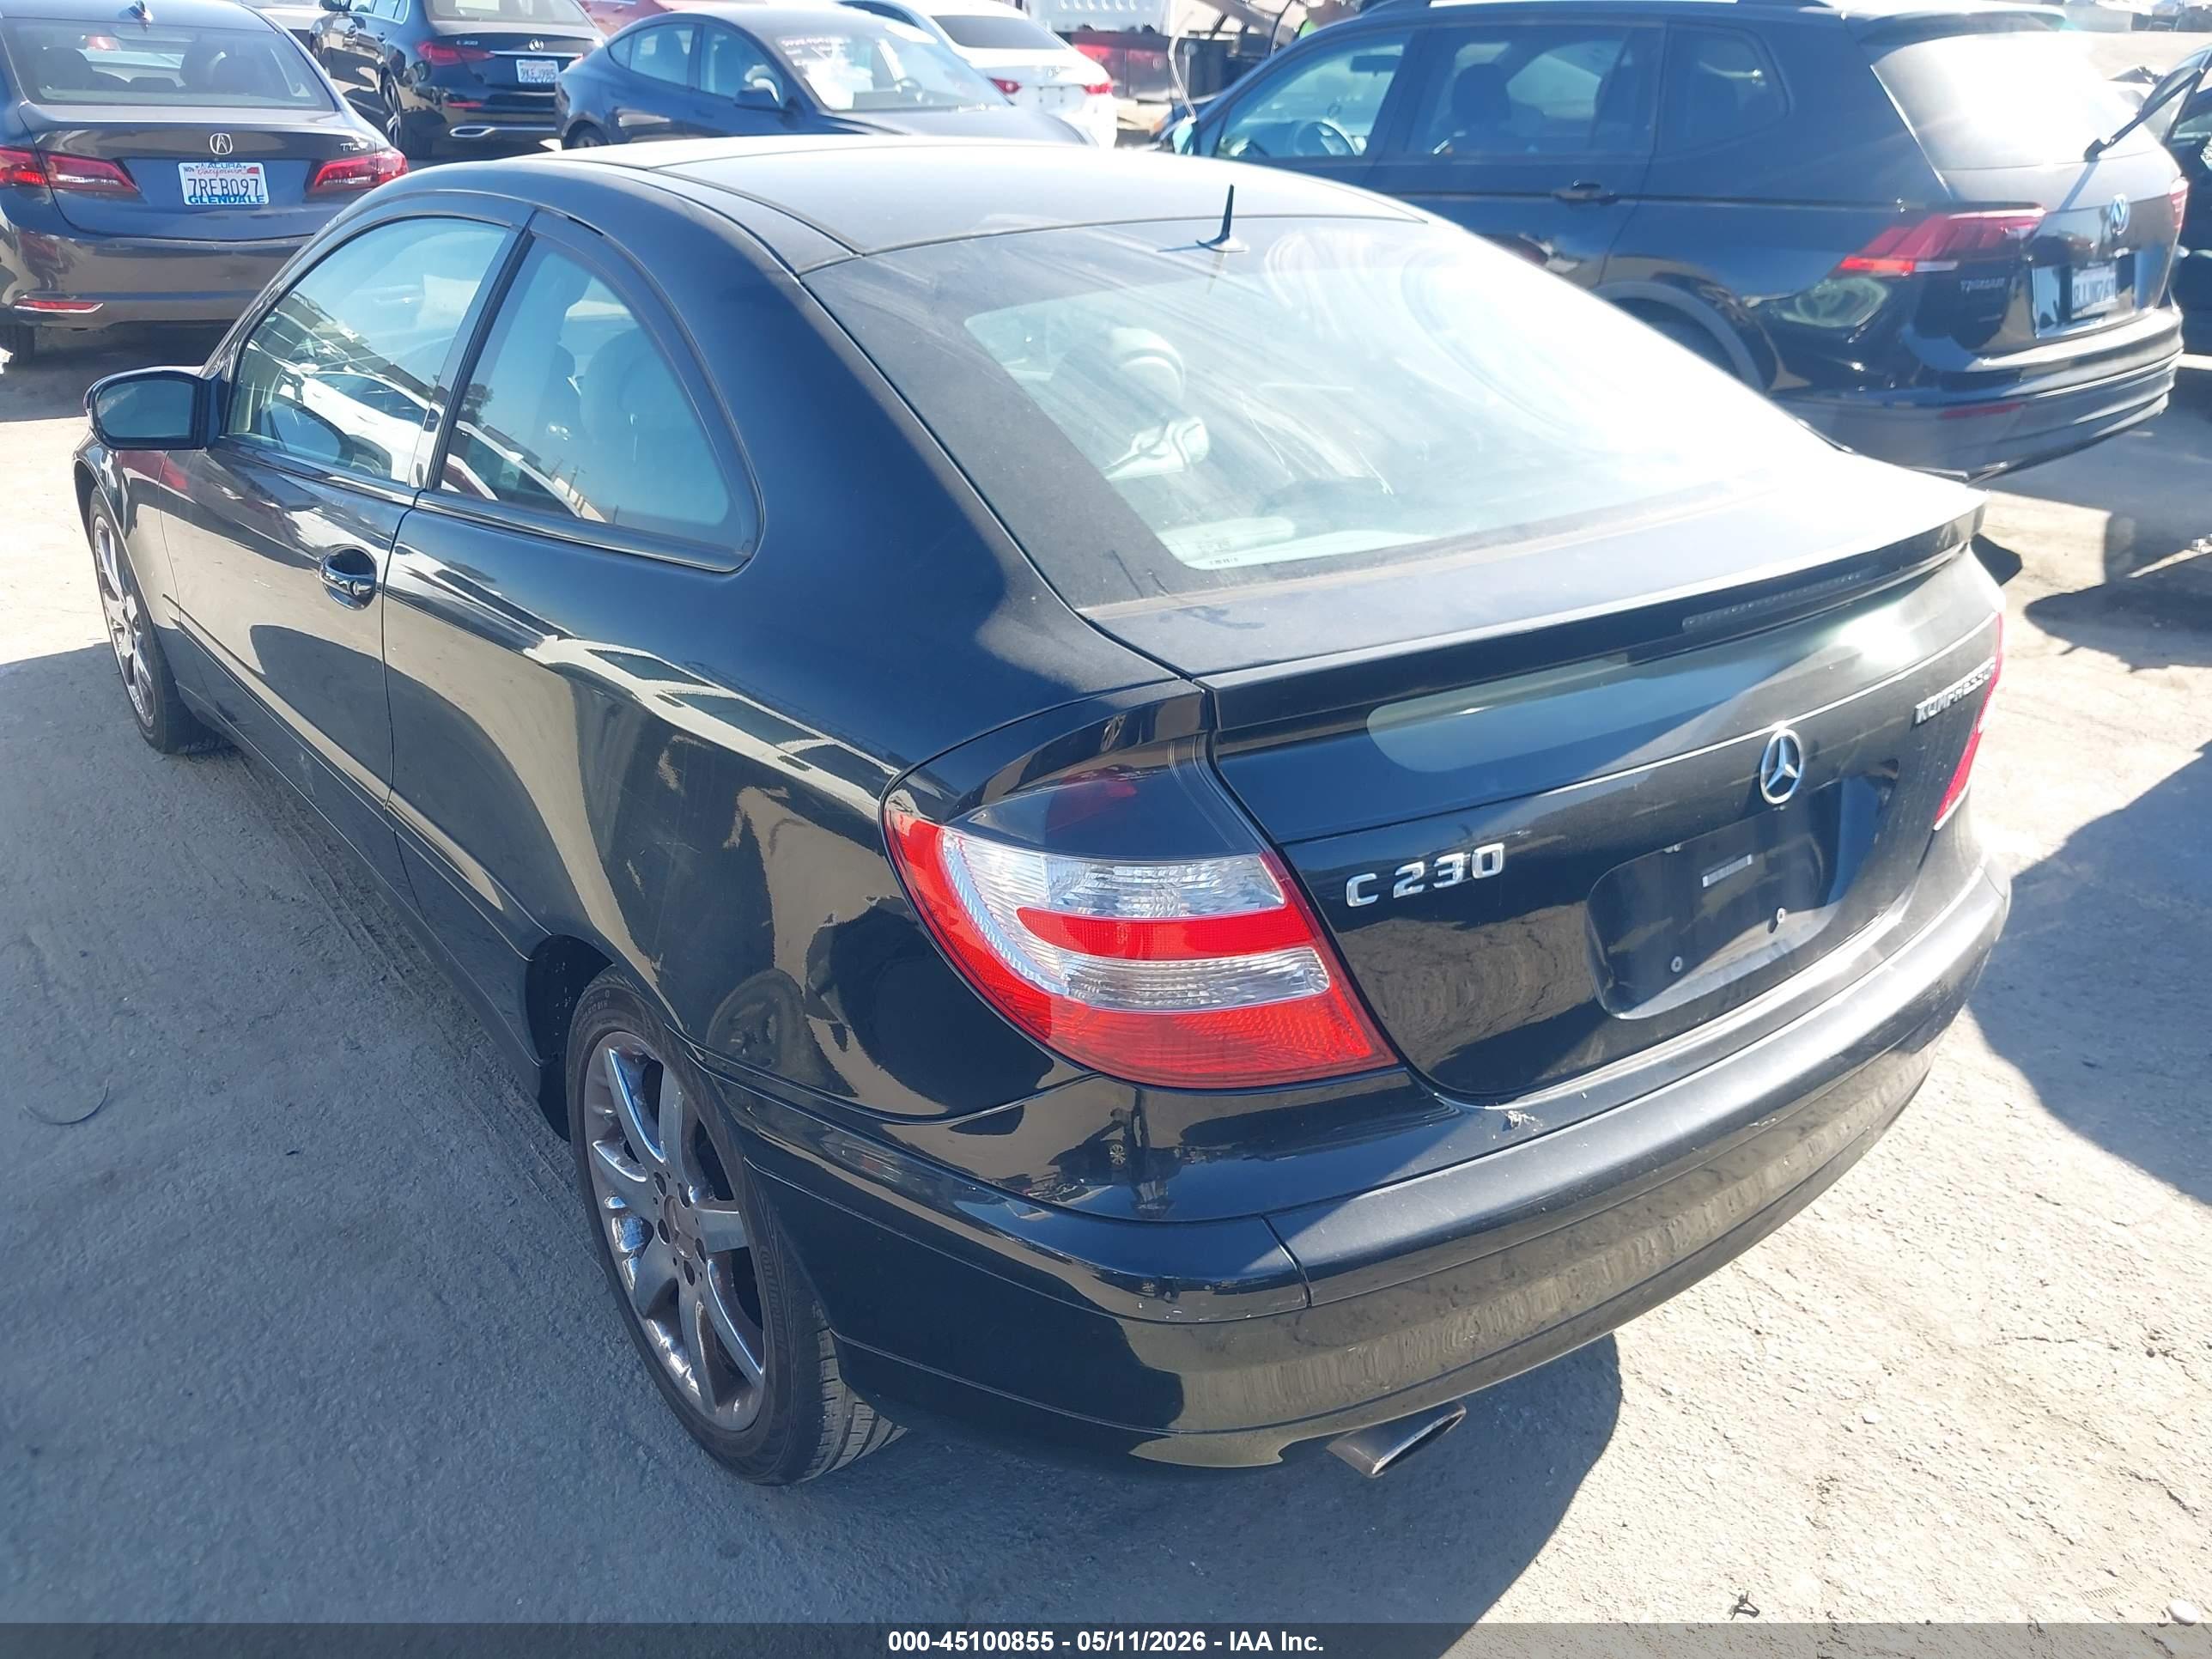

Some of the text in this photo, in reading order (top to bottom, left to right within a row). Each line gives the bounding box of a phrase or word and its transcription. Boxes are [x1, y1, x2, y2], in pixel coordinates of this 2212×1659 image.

[187, 178, 259, 197] 7REB097
[188, 195, 266, 204] GLENDALE
[1346, 842, 1505, 908] C 230
